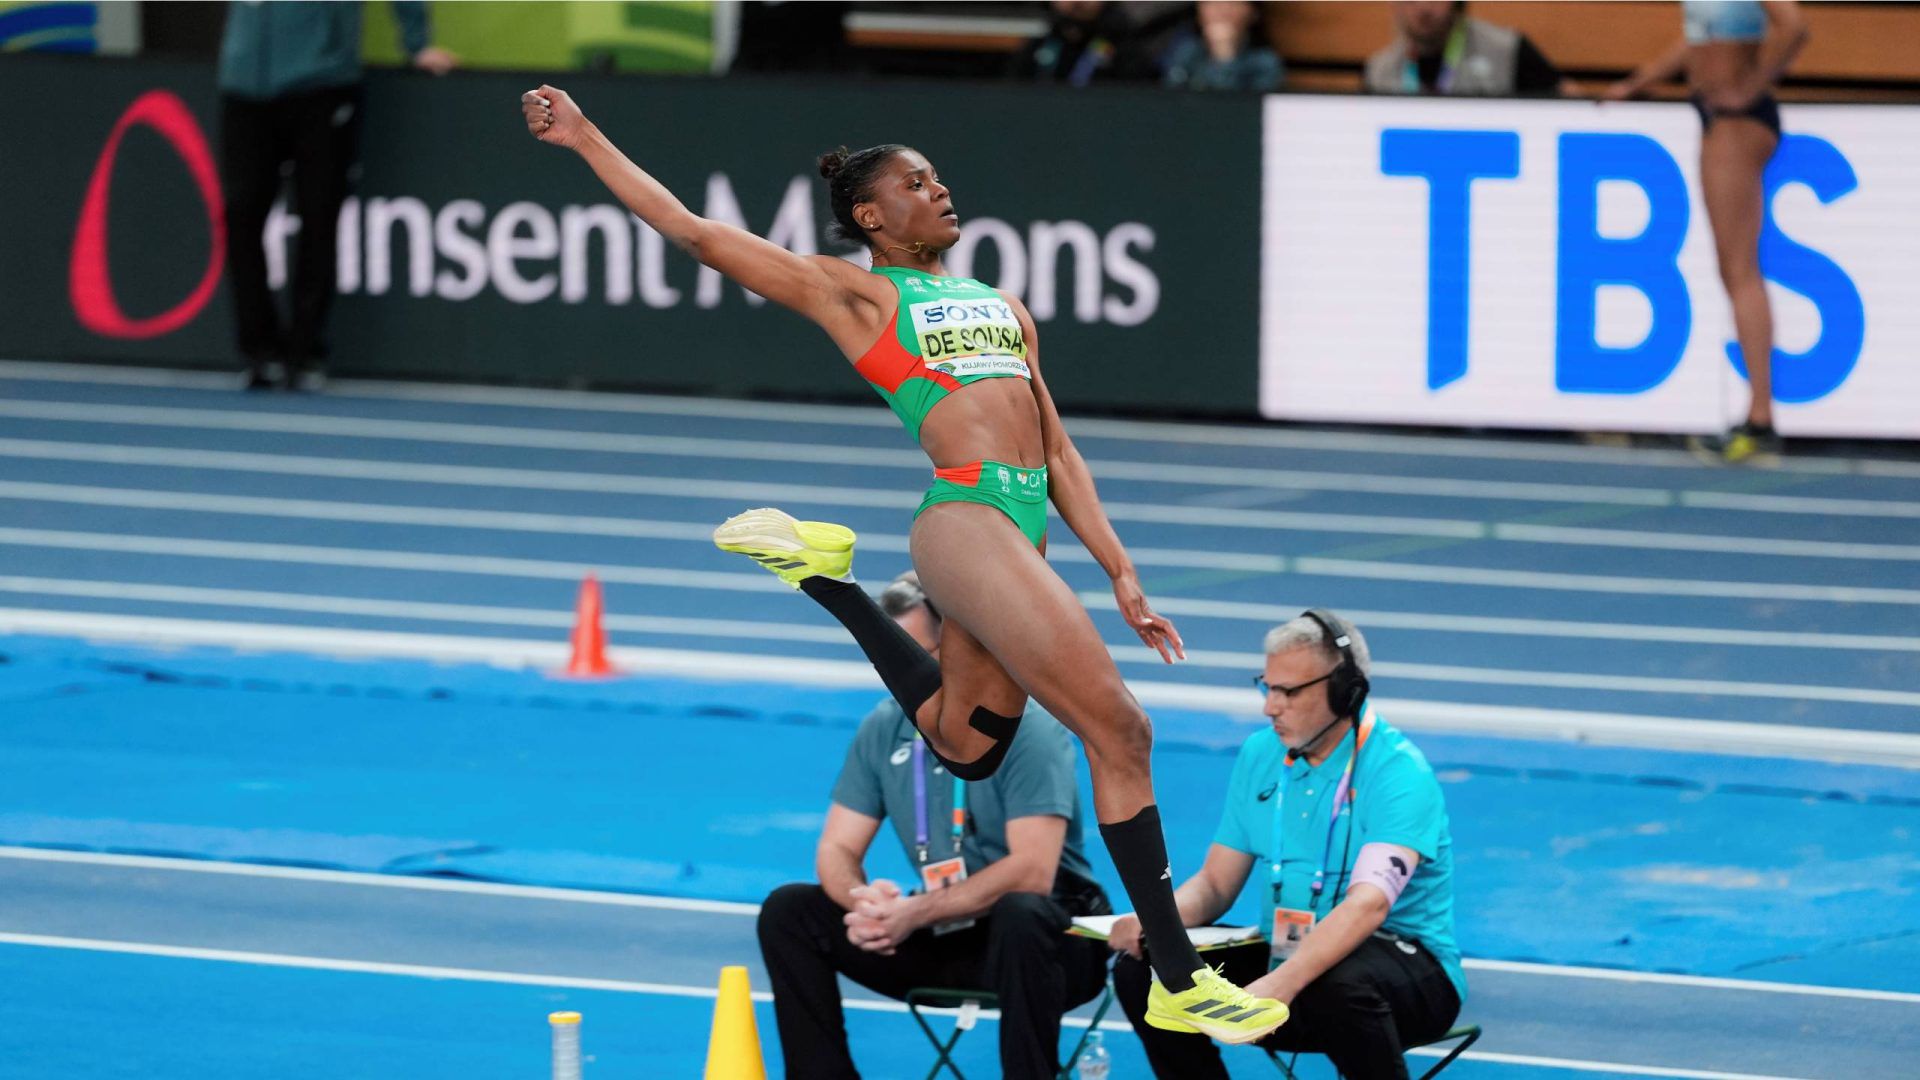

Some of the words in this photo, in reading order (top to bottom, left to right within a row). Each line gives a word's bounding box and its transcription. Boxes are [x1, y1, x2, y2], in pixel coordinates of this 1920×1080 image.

[695, 171, 1160, 326] Mons
[1380, 128, 1865, 404] TBS
[925, 305, 1009, 323] SONY
[925, 331, 957, 357] DE
[960, 327, 1023, 354] SOUSA
[1029, 473, 1041, 488] CA
